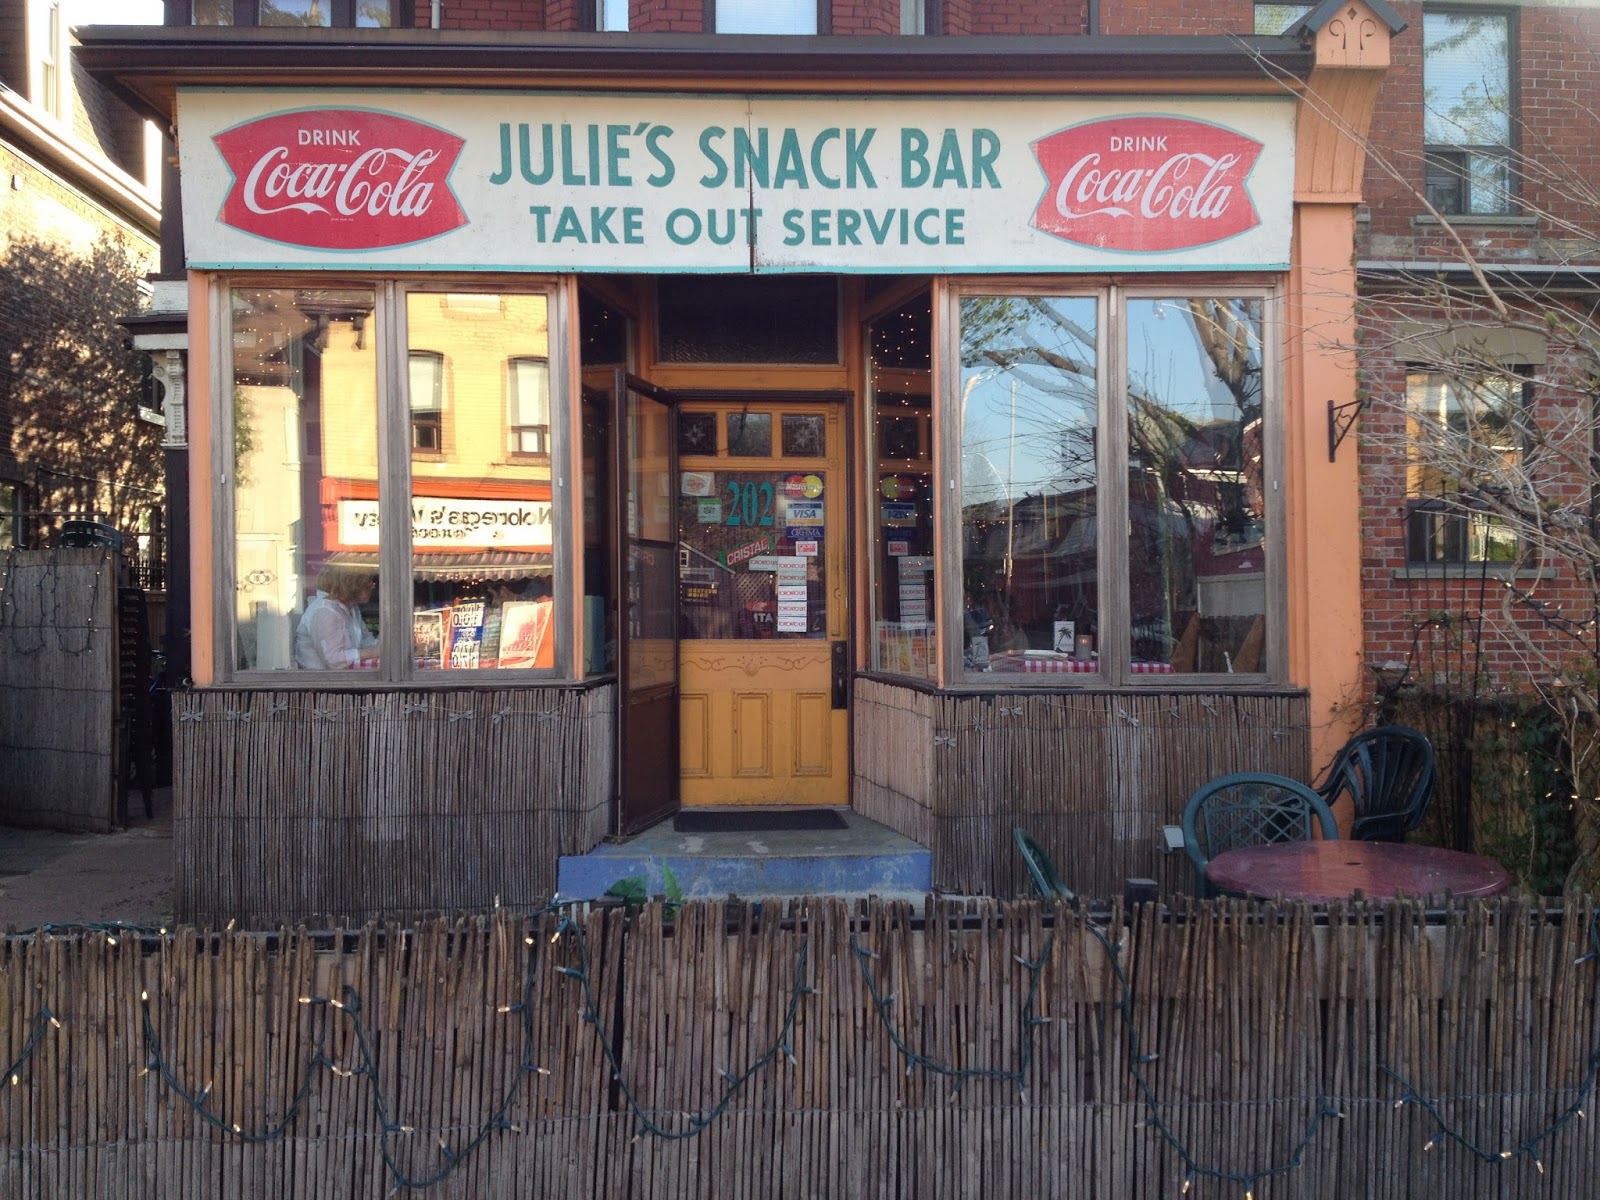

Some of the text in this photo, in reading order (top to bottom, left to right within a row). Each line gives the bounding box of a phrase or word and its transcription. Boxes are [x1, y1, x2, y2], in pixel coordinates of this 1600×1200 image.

[297, 129, 361, 146] DRINK
[489, 122, 1002, 190] JULIE'S SNACK BAR
[1109, 135, 1168, 153] DRINK
[242, 145, 441, 218] Coca-Cola
[1055, 152, 1240, 220] Coca-Cola
[530, 206, 966, 247] TAKE OUT SERVICE
[725, 480, 775, 526] 202
[793, 509, 817, 518] VISA
[726, 537, 769, 566] CRISTAL
